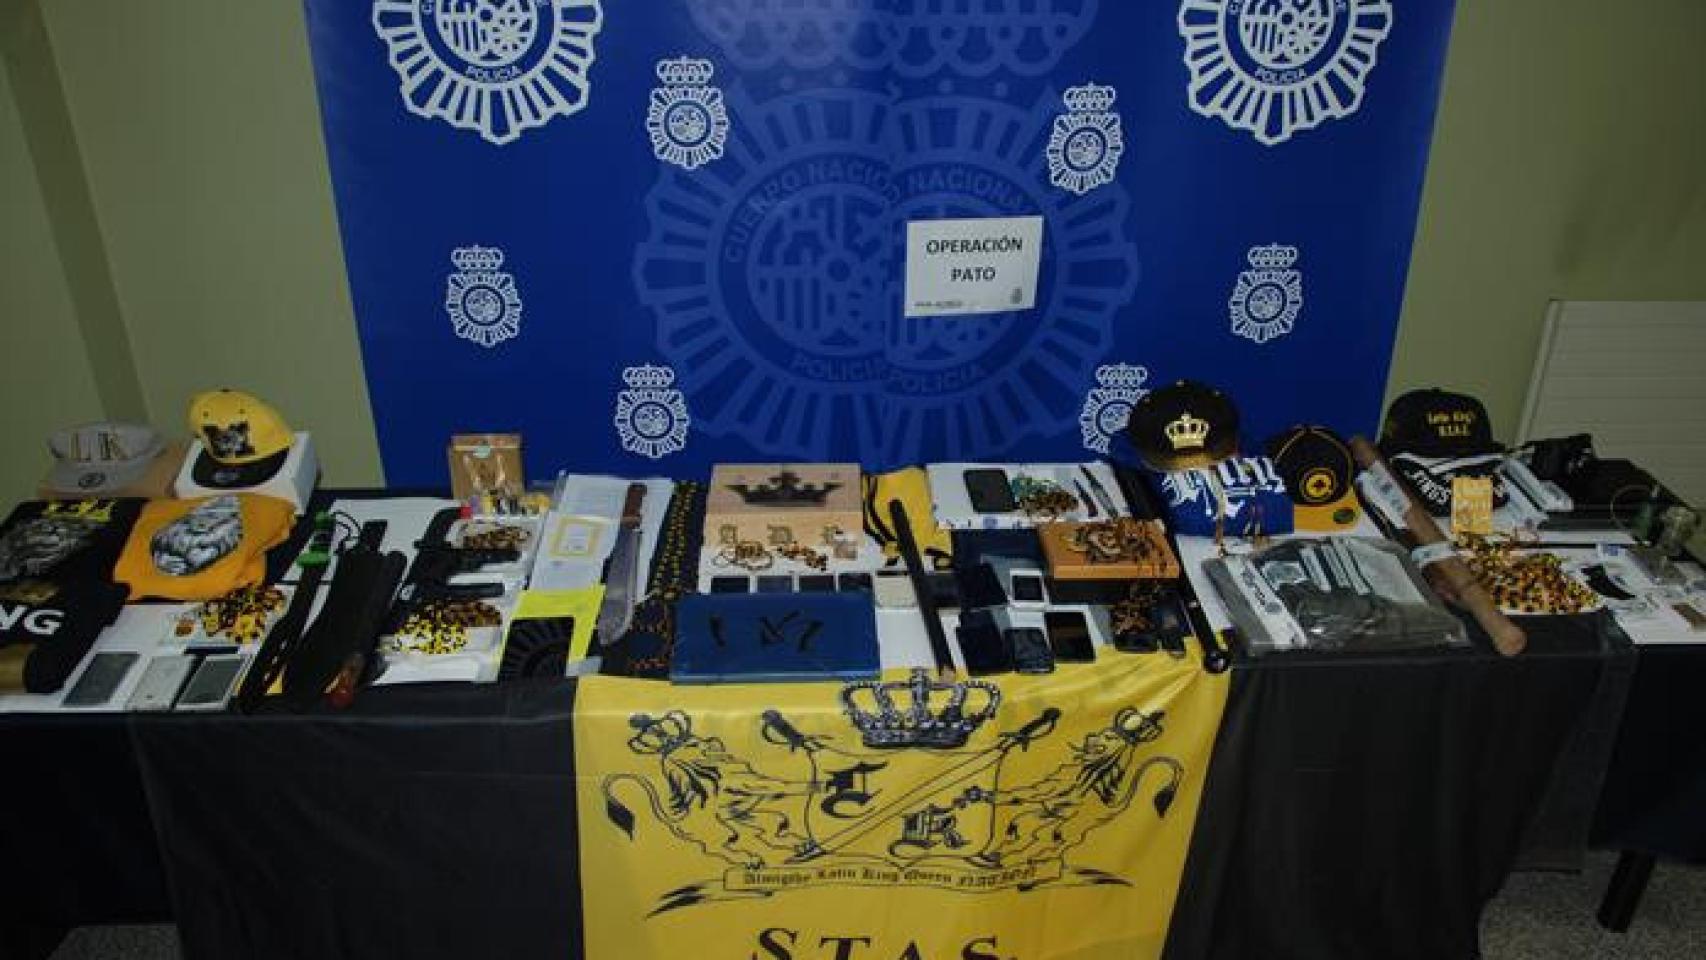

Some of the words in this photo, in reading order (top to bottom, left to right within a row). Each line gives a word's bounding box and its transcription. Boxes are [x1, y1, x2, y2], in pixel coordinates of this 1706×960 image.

[926, 234, 1023, 254] OPERACIÓN
[950, 266, 996, 283] PATO
[862, 867, 898, 881] King
